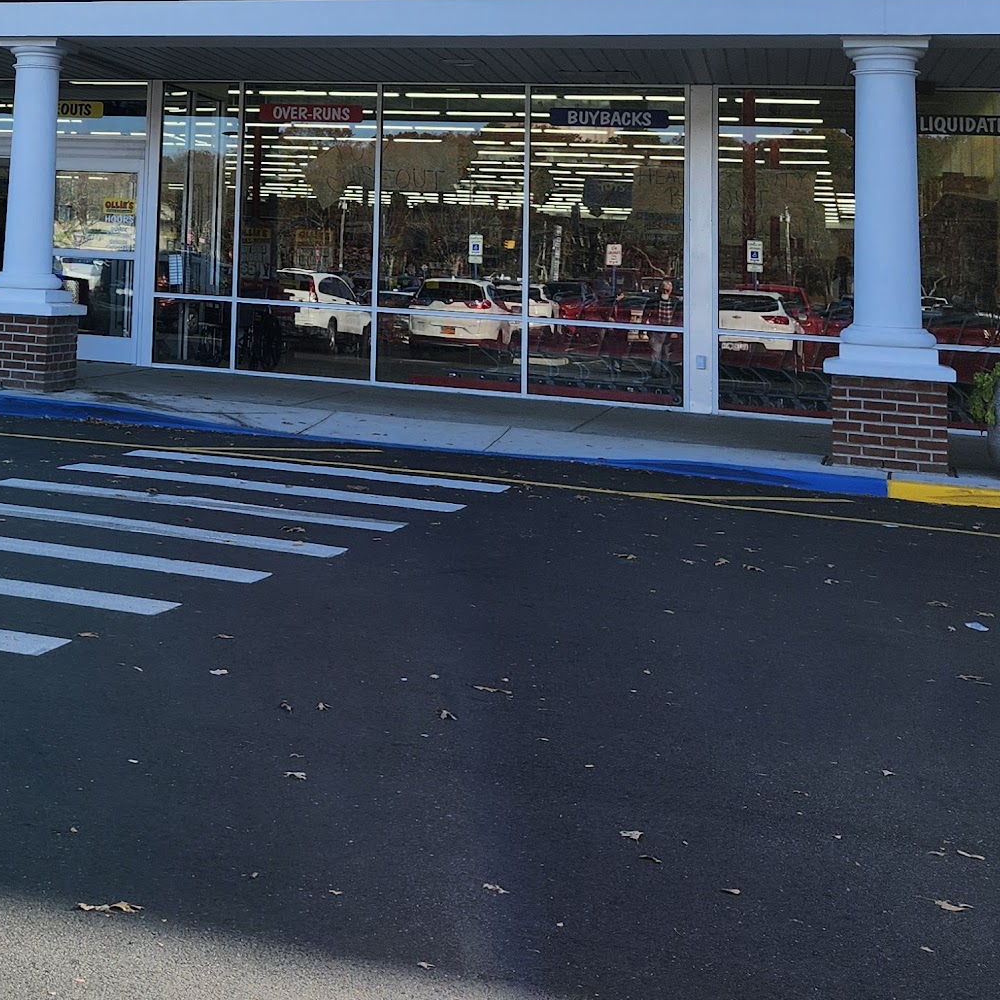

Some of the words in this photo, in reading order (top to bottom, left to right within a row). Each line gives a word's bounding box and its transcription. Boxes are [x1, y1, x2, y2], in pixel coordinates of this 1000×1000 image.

[272, 106, 351, 121] OVER-RUNS
[567, 109, 652, 126] BUYBACKS
[104, 214, 134, 225] HOURS
